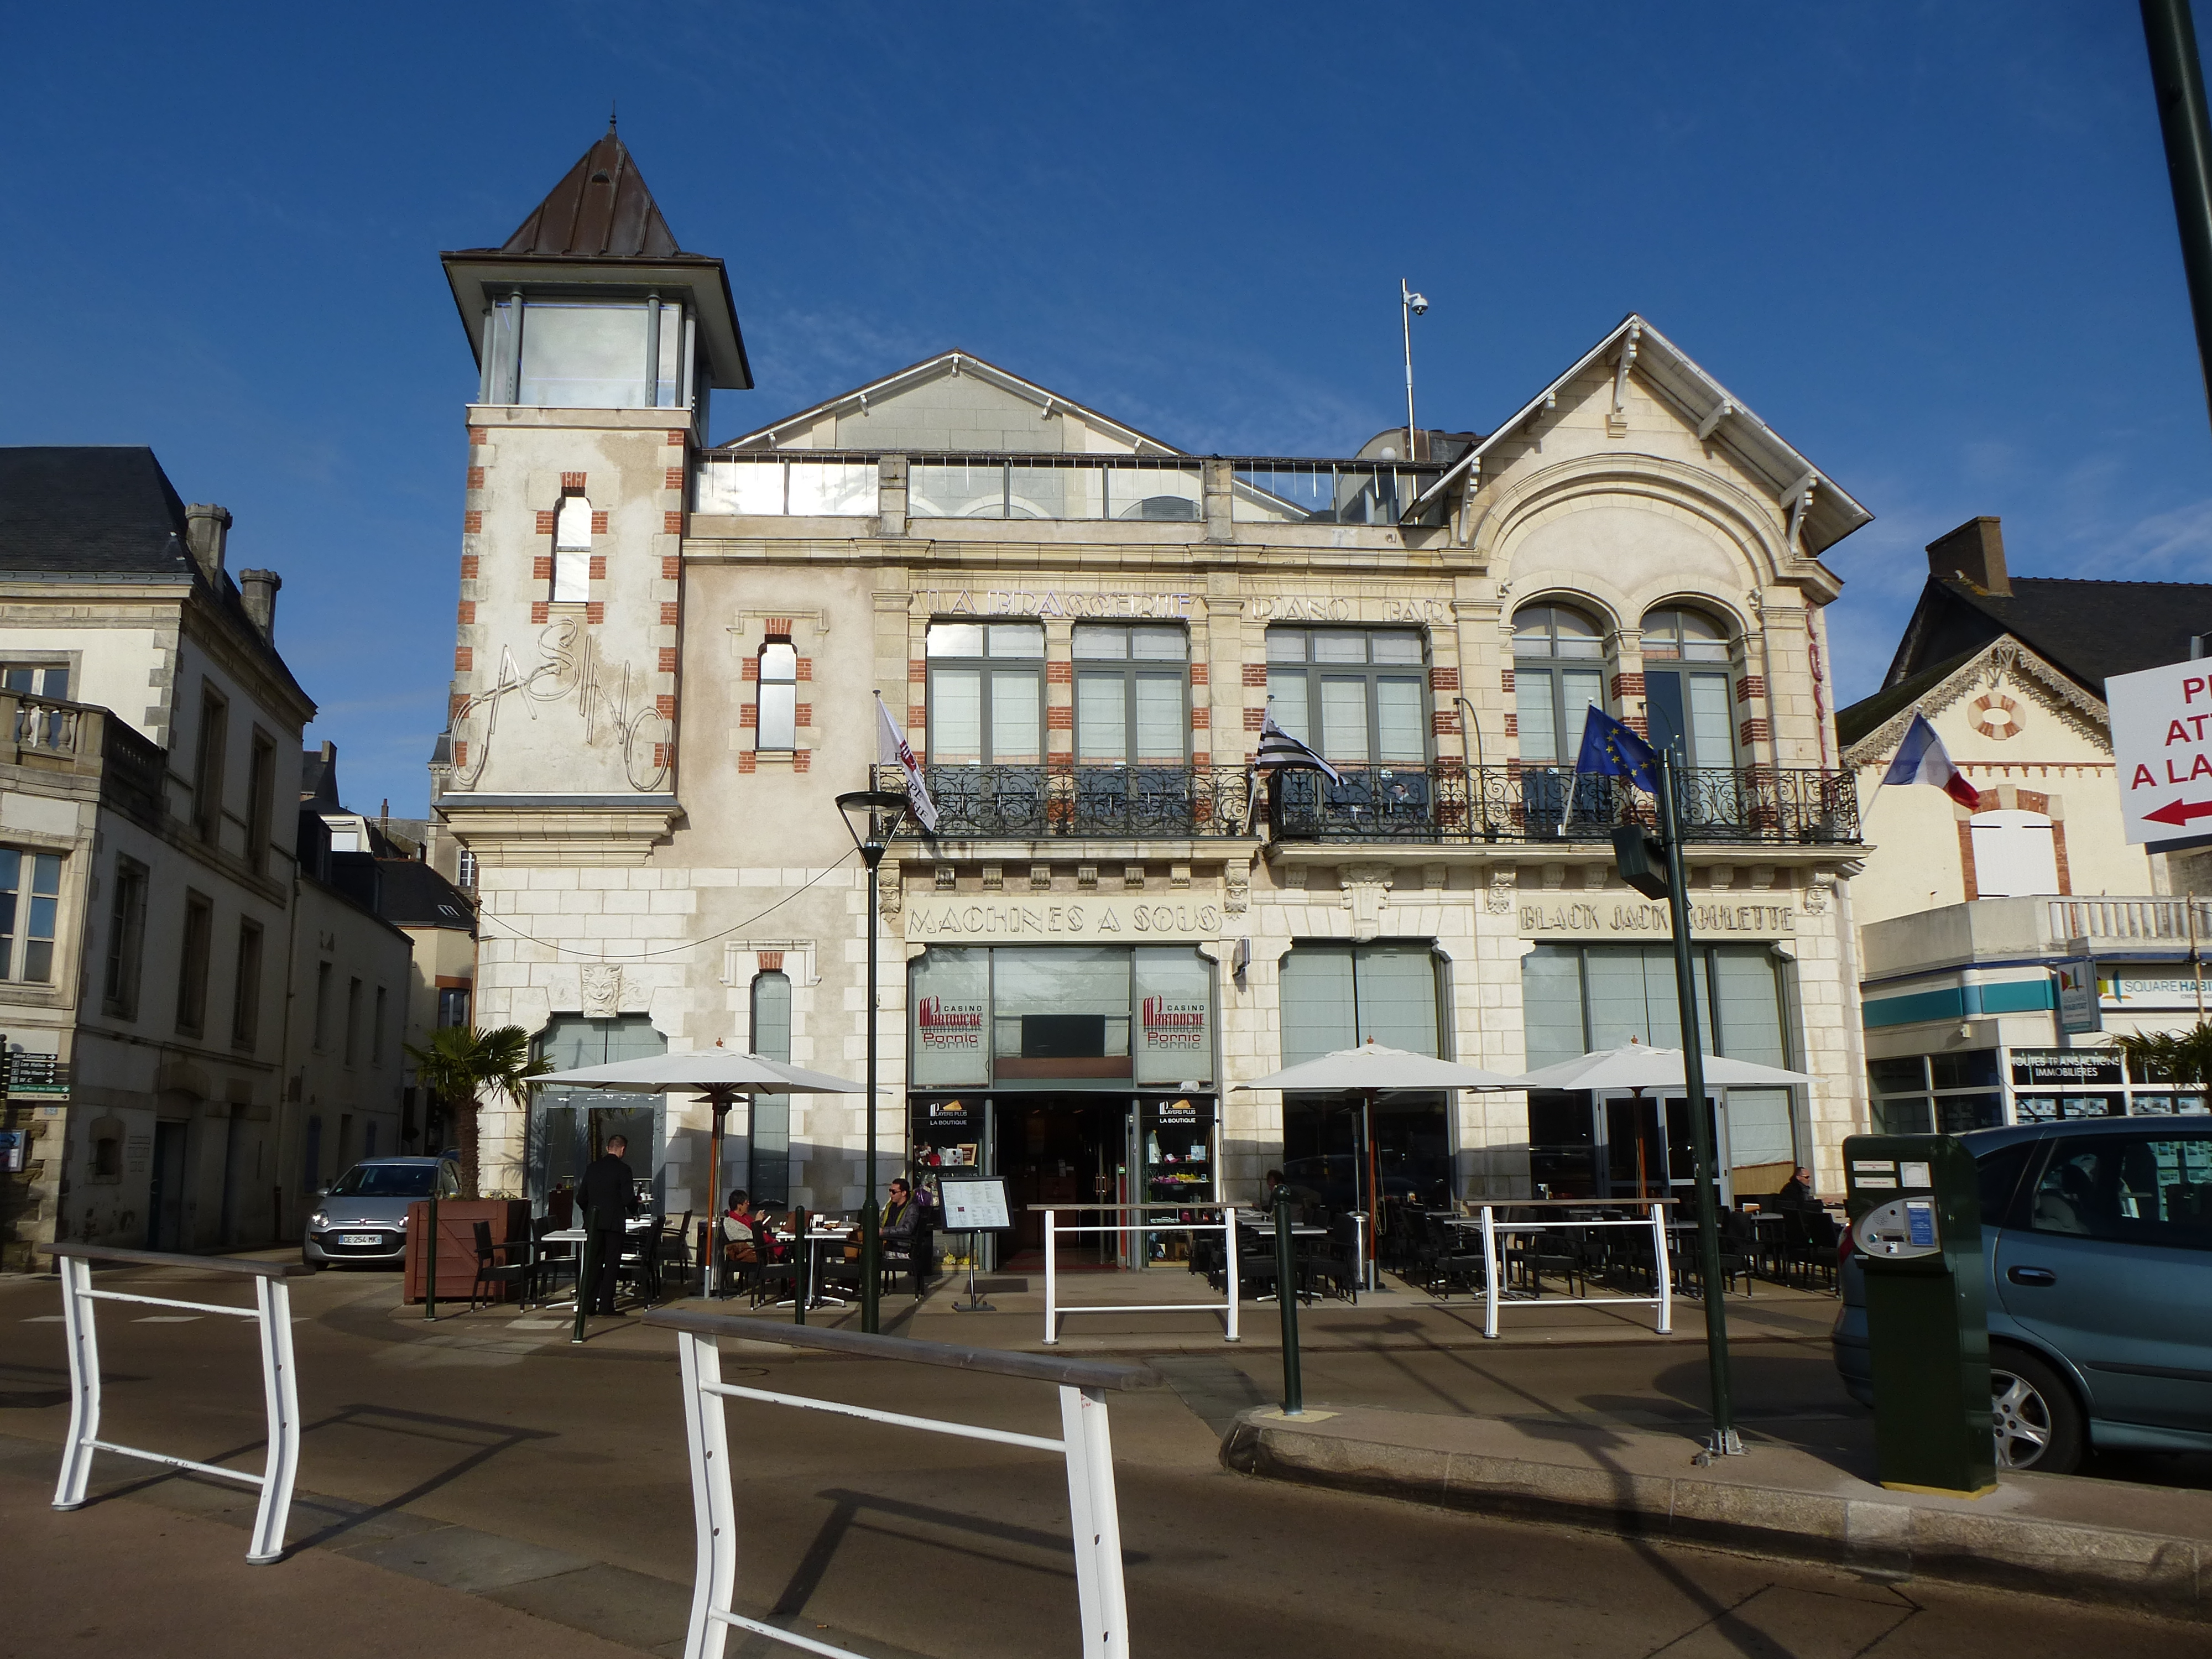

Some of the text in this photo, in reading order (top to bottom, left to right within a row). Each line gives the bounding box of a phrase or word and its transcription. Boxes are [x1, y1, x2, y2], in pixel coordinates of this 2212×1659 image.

[928, 589, 1190, 618] LA BRASSERIE
[1253, 596, 1444, 623] PIANO BAR
[450, 616, 670, 792] CASINO
[2165, 713, 2212, 747] AT
[2131, 763, 2157, 790] A
[909, 905, 1222, 934] MACHINES A SOUS
[1520, 904, 1794, 931] BLACK JACK OULETTE
[2125, 980, 2212, 992] SQUARE HABI
[924, 1032, 978, 1042] Pornic
[1147, 1032, 1201, 1042] Pornic
[2011, 1057, 2046, 1066] TOUTES
